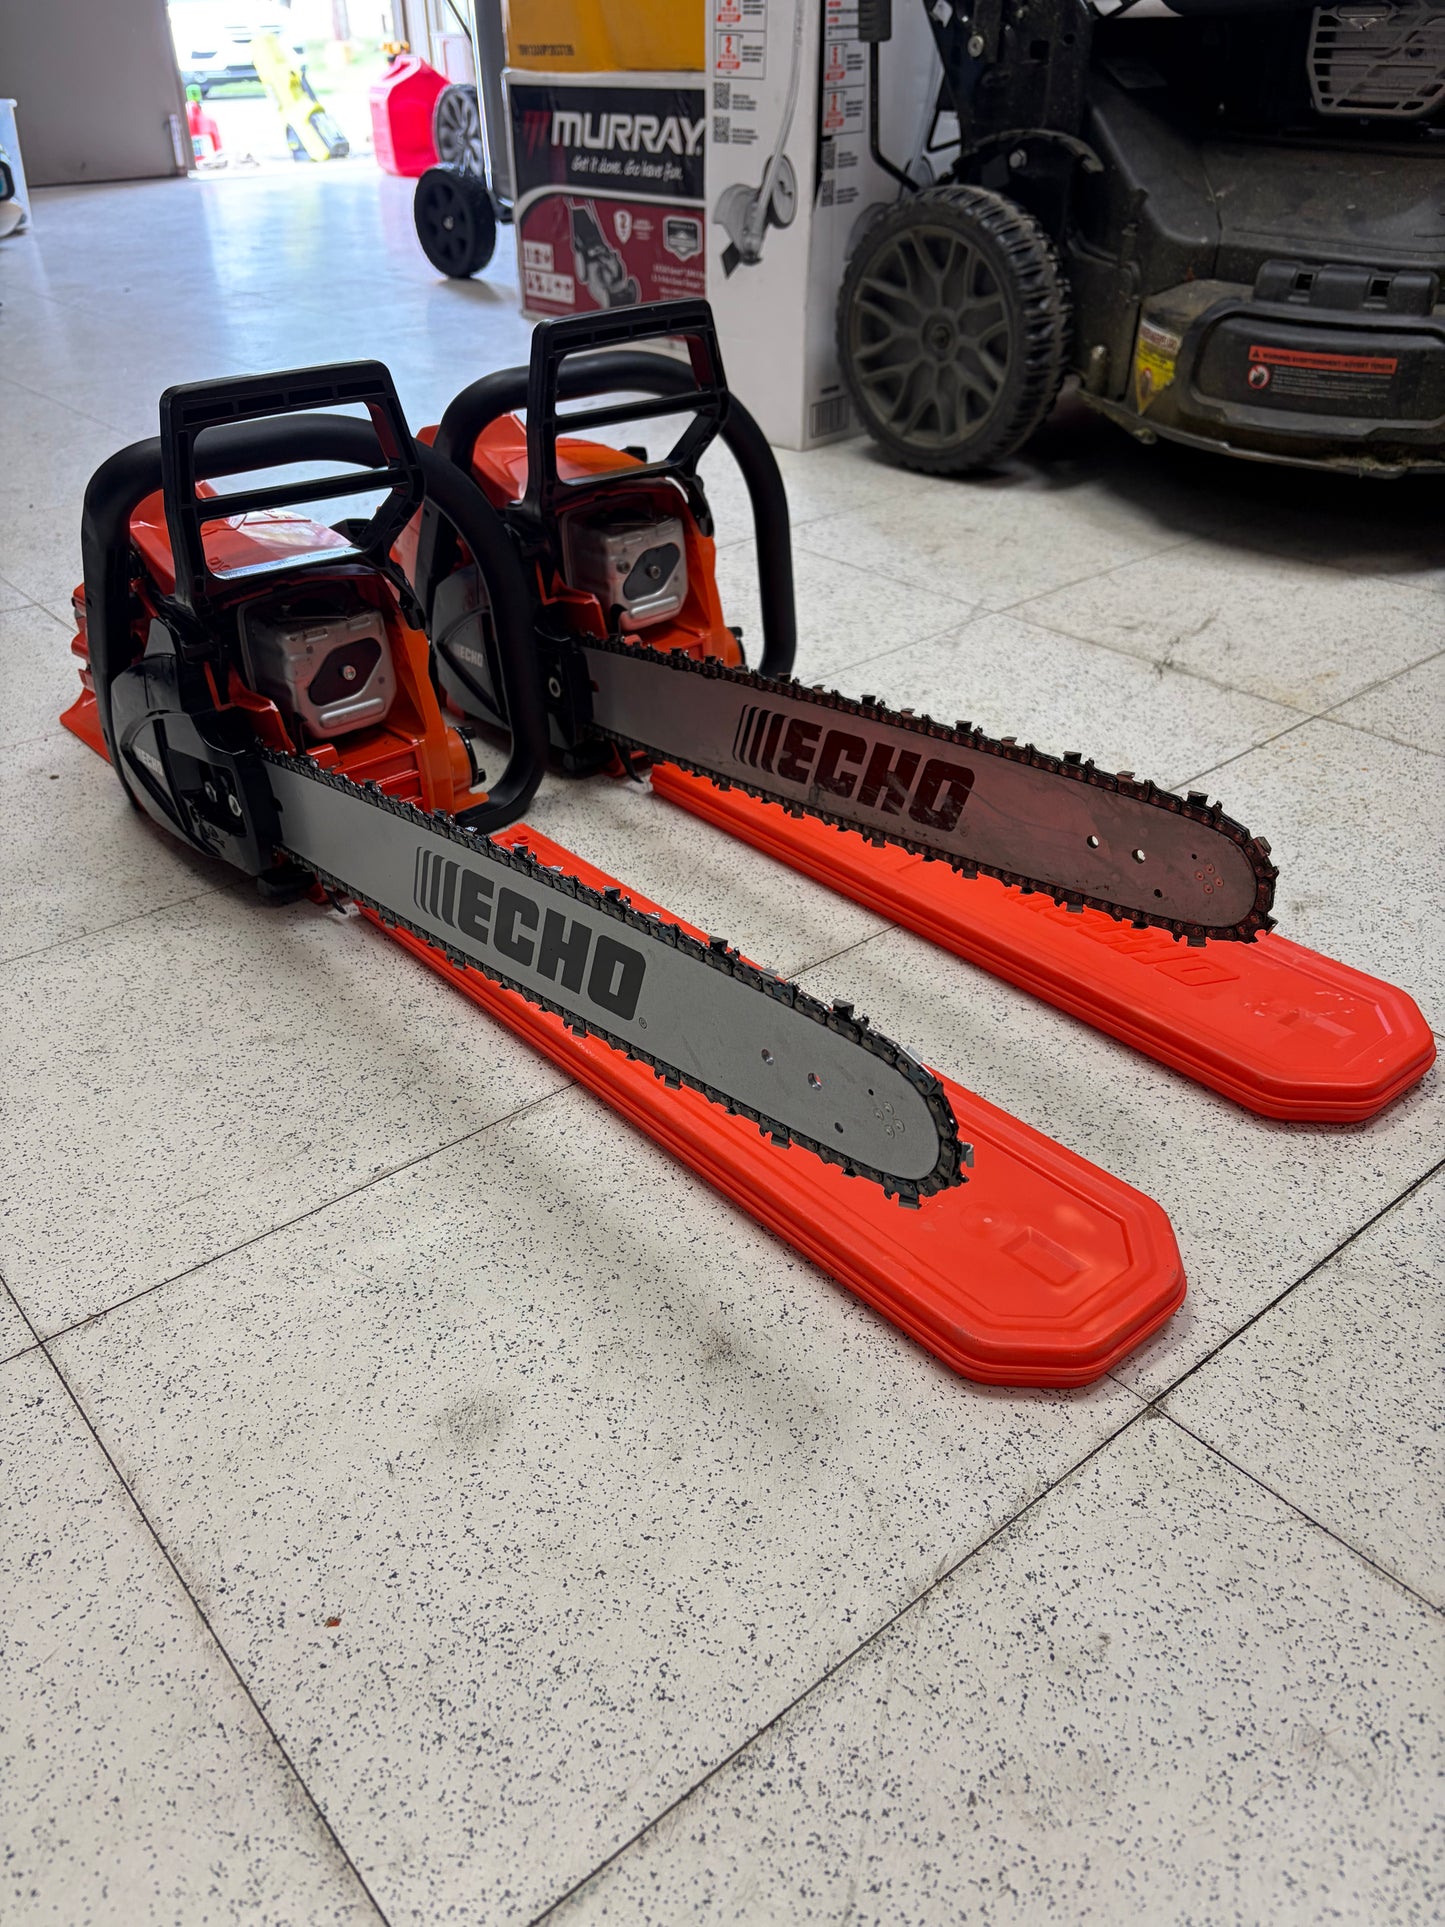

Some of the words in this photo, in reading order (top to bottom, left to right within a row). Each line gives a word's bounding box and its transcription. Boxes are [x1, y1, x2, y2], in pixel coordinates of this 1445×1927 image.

[552, 111, 704, 156] MURRAY
[571, 155, 588, 171] Get
[460, 645, 483, 668] ECHO
[777, 718, 976, 833] ECHO
[457, 868, 647, 1021] ECHO
